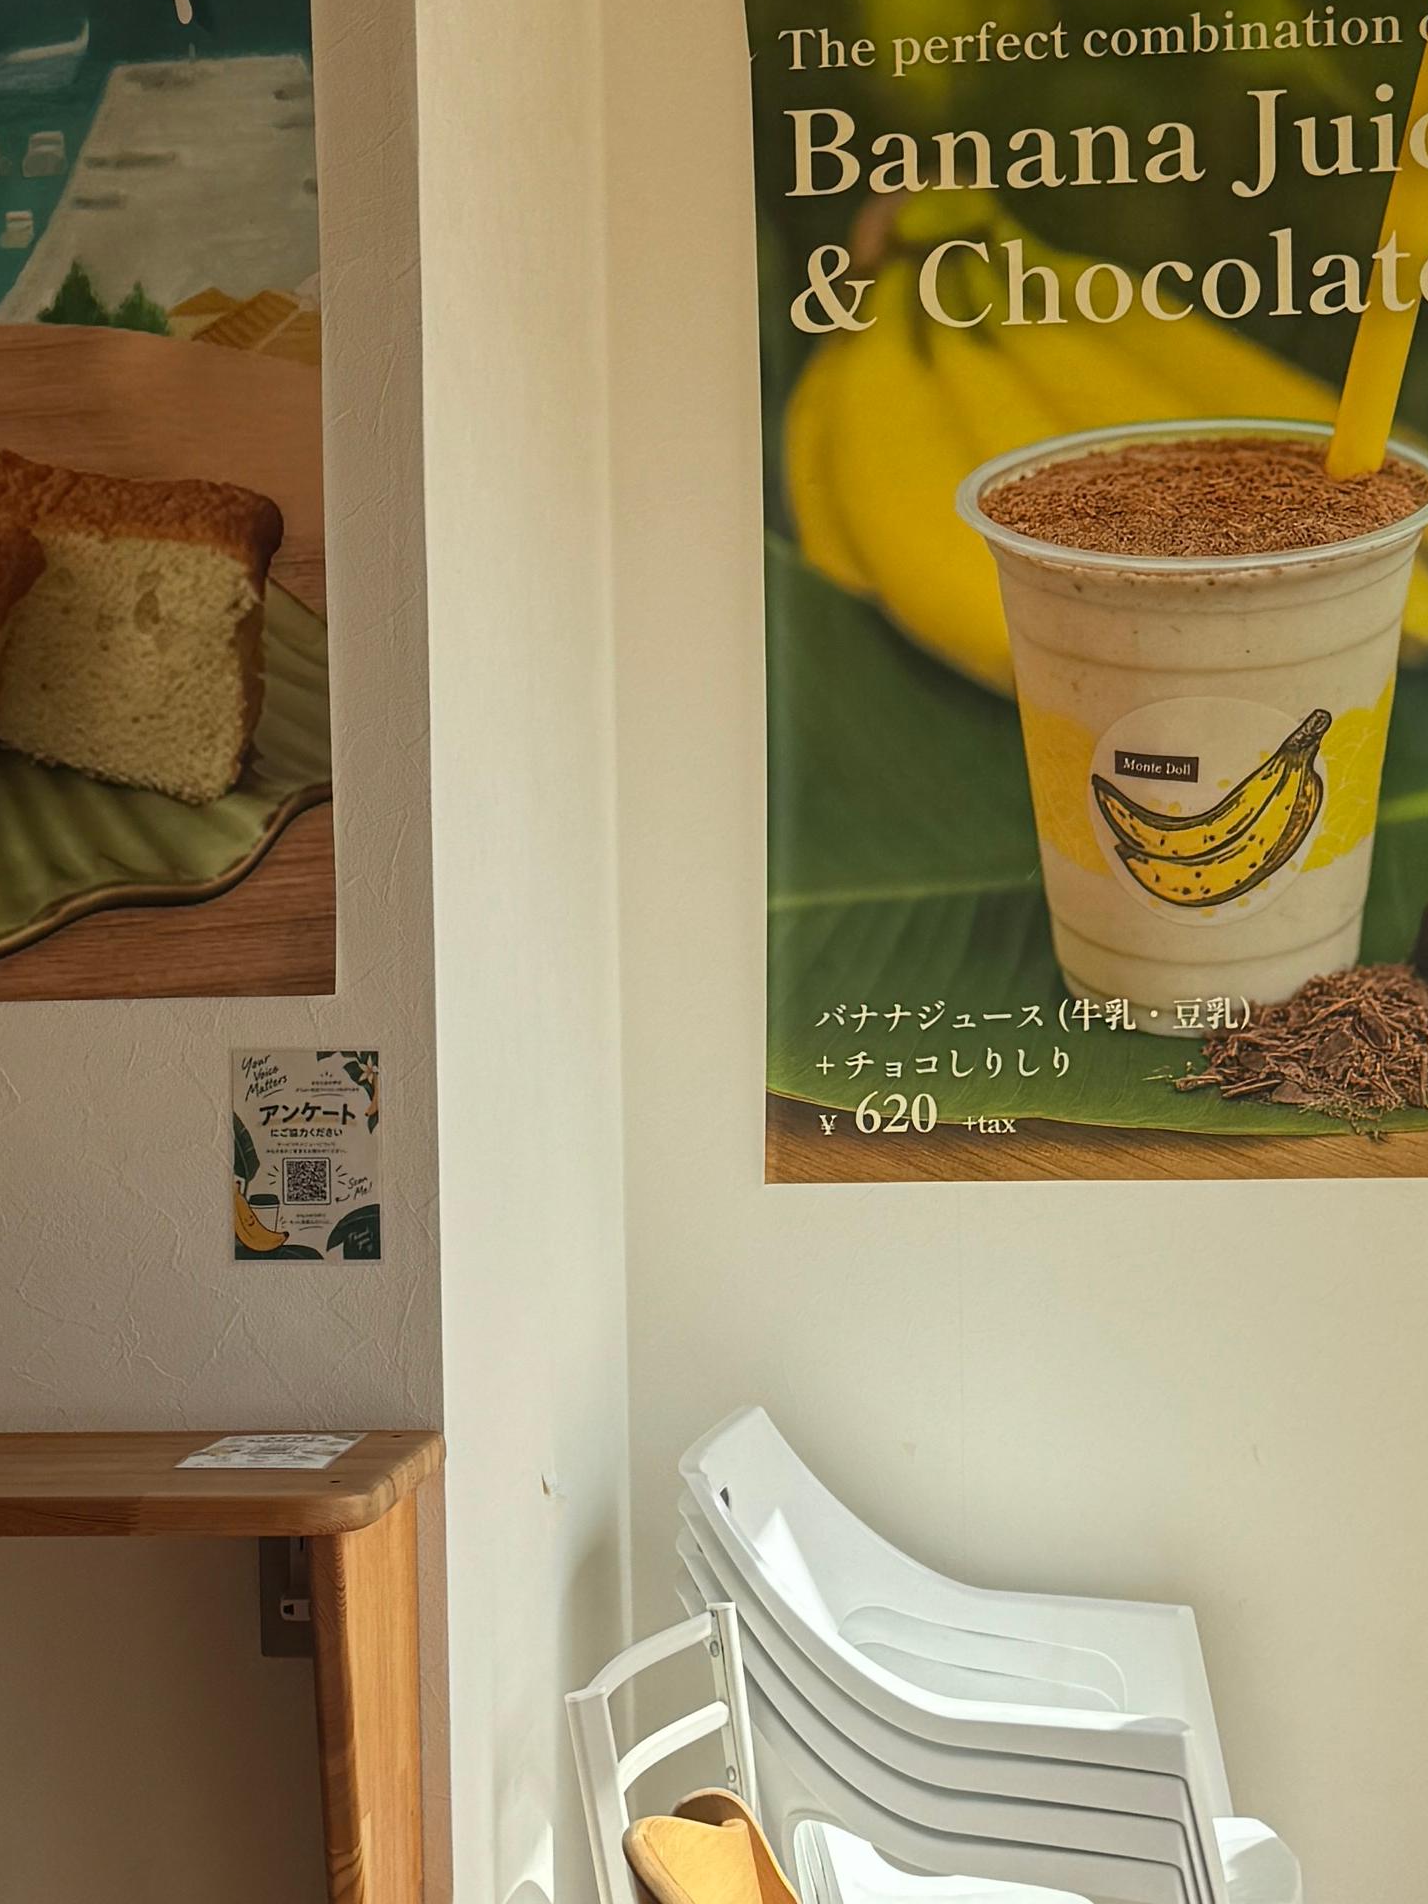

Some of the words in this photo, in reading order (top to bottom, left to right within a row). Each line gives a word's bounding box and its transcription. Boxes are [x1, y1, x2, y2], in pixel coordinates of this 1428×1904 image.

[778, 26, 877, 72] The
[891, 19, 1070, 78] perfect
[1082, 4, 1404, 60] combination
[782, 107, 1207, 199] Banana
[789, 242, 878, 335] &
[1123, 757, 1162, 774] Monte
[1166, 762, 1191, 776] Doll
[241, 1054, 270, 1078] Your
[245, 1074, 288, 1102] Matters
[259, 1101, 356, 1126] アンケート
[853, 1092, 939, 1136] 620
[964, 1114, 1018, 1136] +tax
[270, 1127, 343, 1138] にご協力ください
